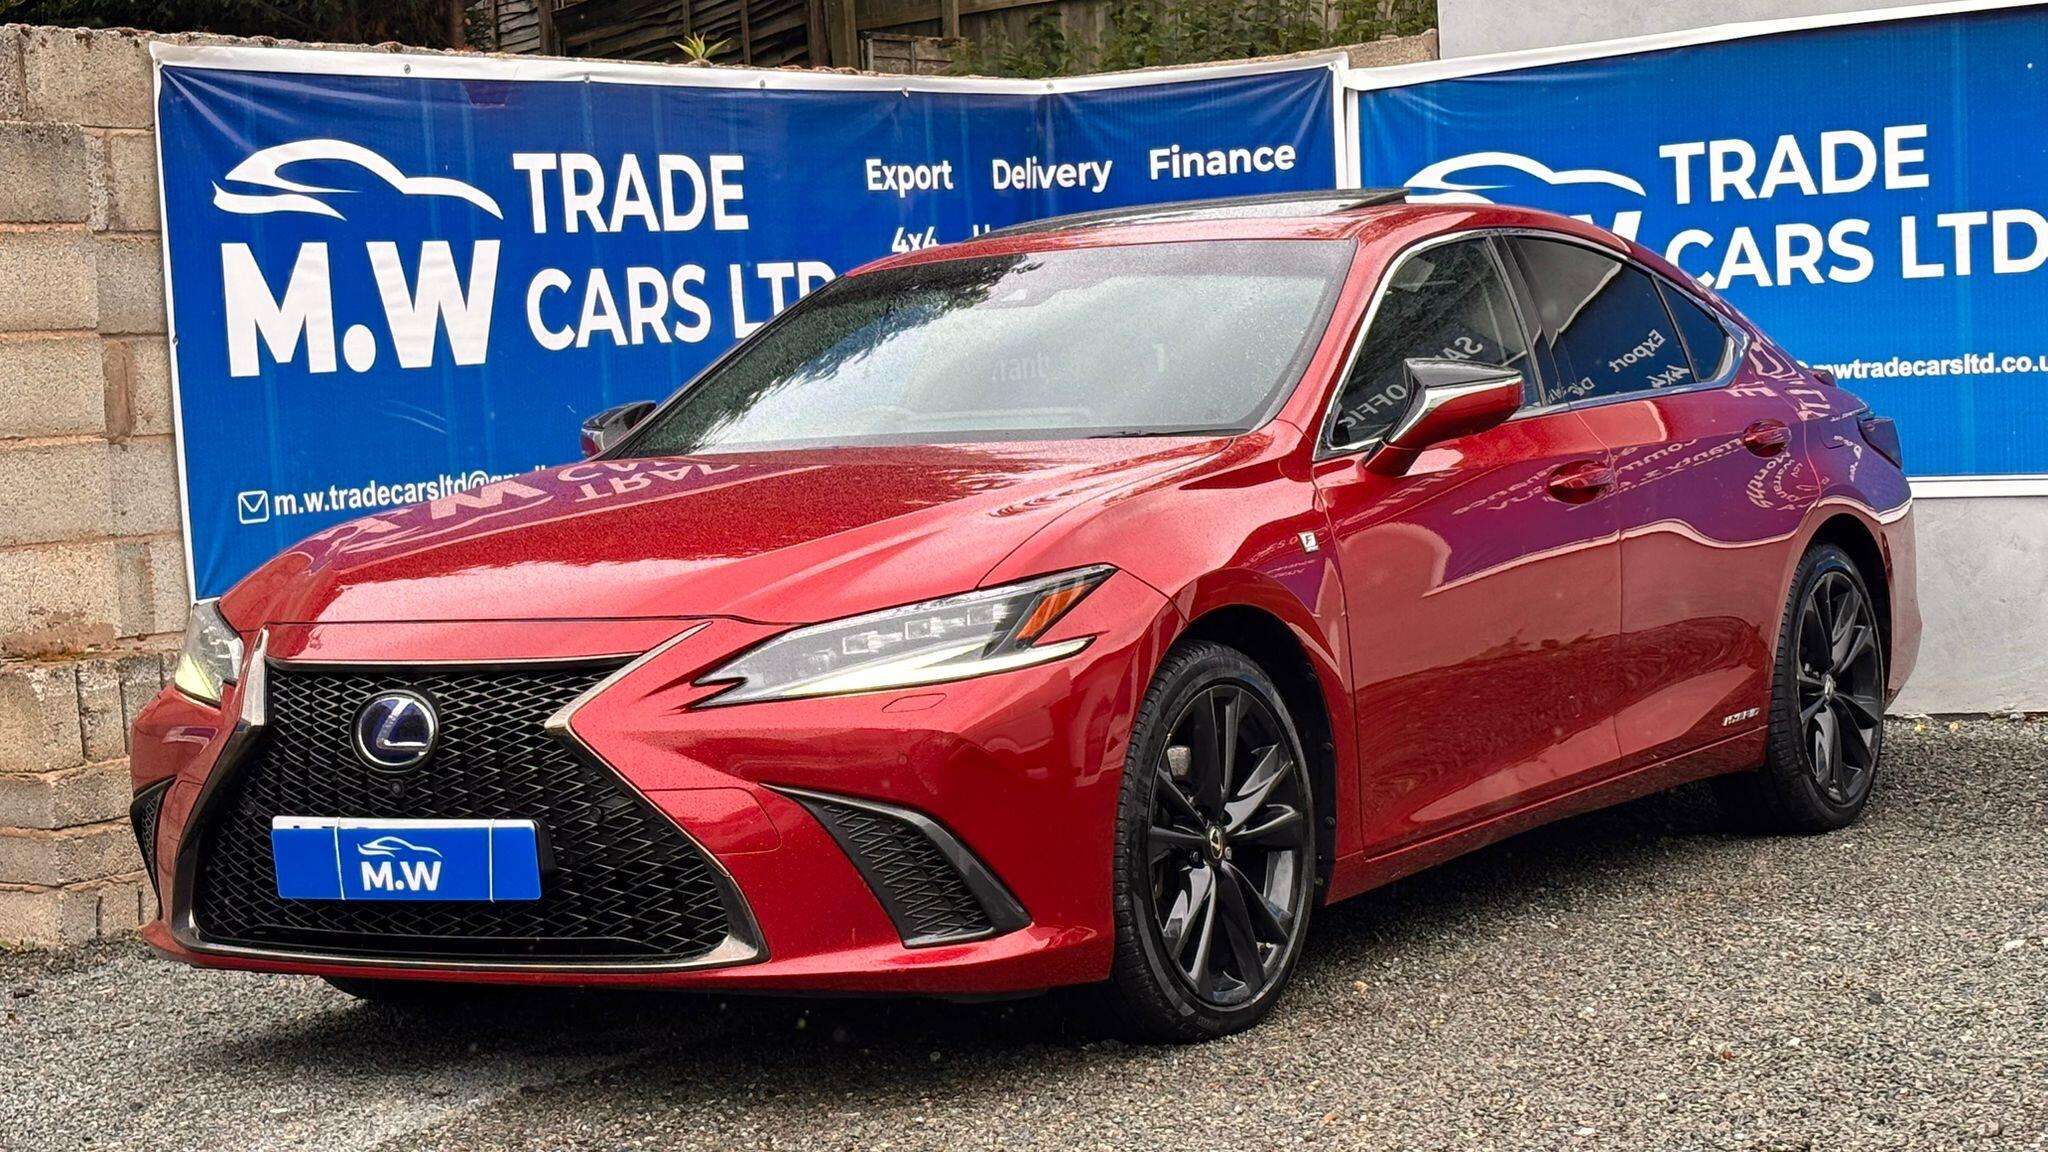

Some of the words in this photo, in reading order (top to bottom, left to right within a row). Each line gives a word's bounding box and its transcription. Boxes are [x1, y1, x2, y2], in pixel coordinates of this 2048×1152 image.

[865, 158, 953, 197] Export
[992, 157, 1112, 193] Delivery
[1149, 143, 1296, 181] Finance
[1658, 124, 1930, 205] TRADE
[513, 153, 749, 234] TRADE
[891, 226, 940, 253] 4x4
[1665, 218, 1875, 290] CARS
[1901, 208, 2048, 279] LTD
[221, 239, 501, 378] M.W
[527, 264, 711, 350] CARS
[1797, 351, 2048, 379] wtradecarsltd.co.u
[360, 860, 442, 892] M.W
